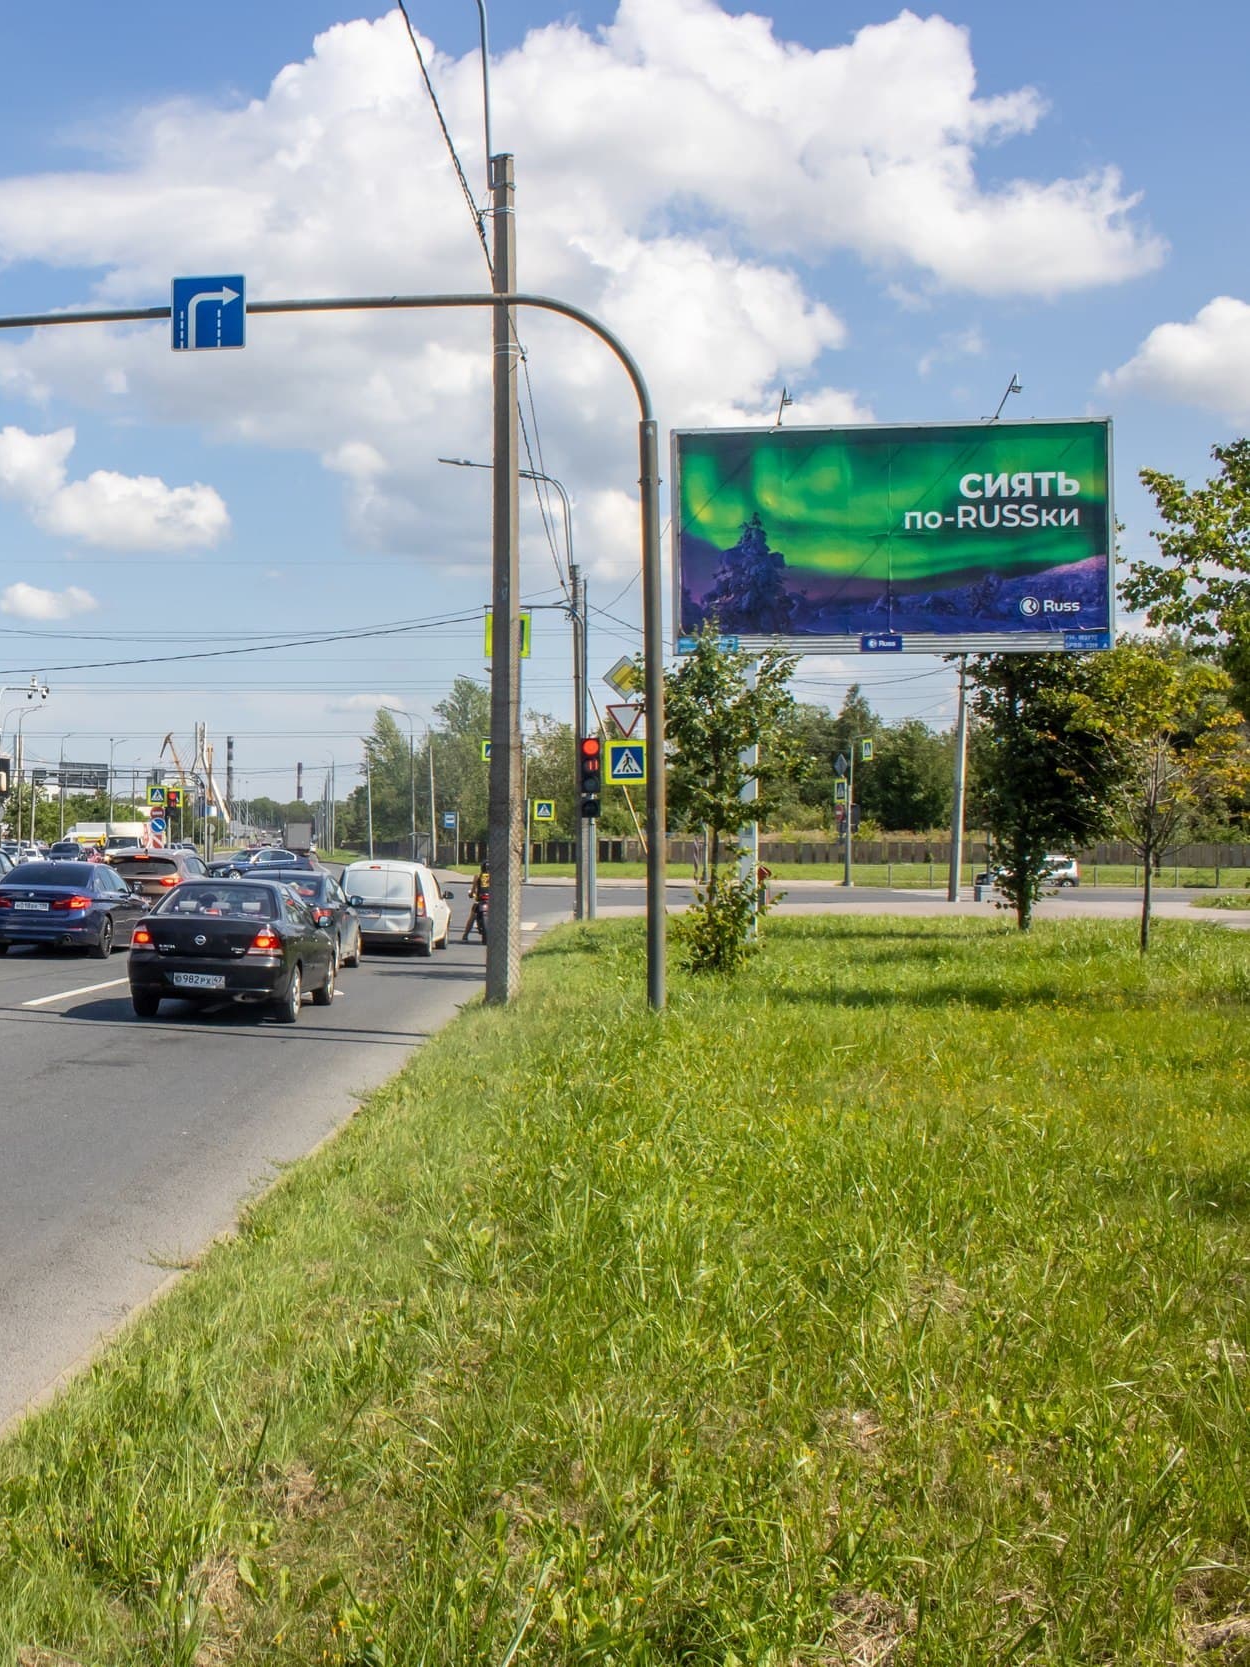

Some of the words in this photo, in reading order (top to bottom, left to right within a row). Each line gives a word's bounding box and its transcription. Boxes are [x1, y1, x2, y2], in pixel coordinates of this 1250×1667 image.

[958, 471, 1081, 498] СИЯТЬ
[904, 504, 1079, 529] по-RUSSки
[1043, 599, 1080, 612] Russ
